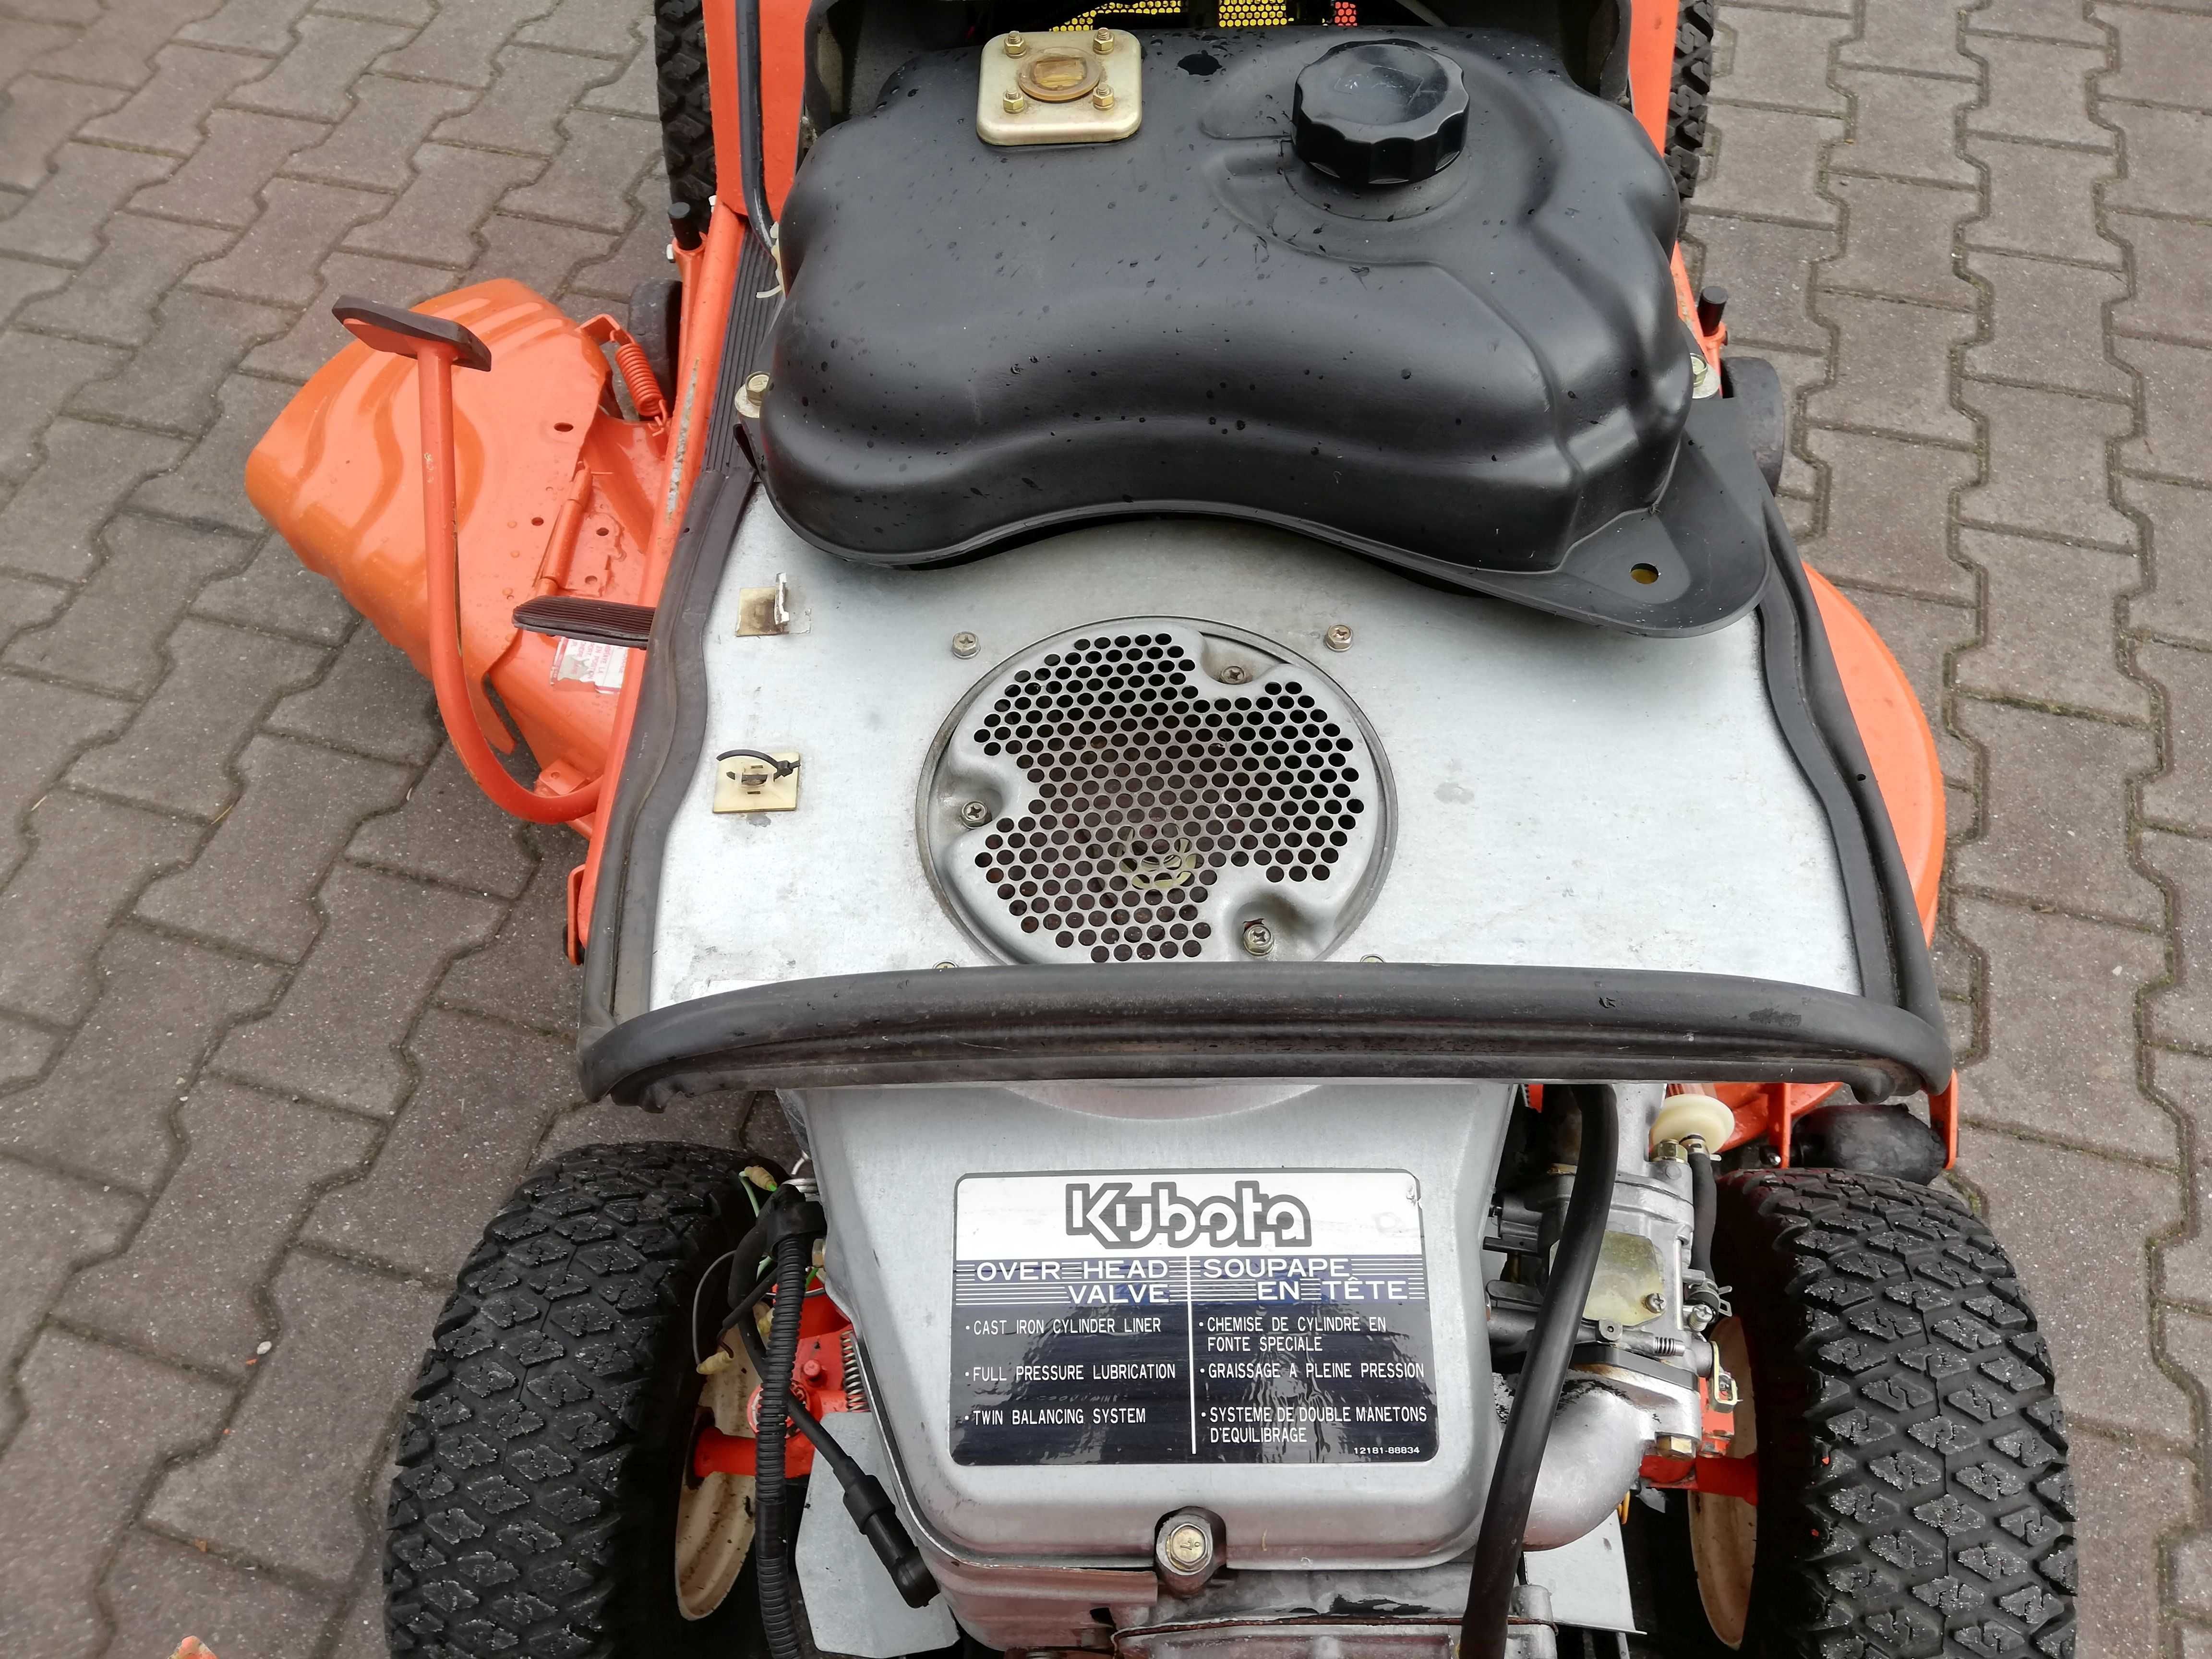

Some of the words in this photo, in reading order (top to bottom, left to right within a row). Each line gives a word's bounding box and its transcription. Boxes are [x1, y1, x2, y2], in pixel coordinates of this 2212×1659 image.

[1066, 1180, 1312, 1249] Kubota
[977, 1261, 1060, 1281] OVER
[1084, 1260, 1168, 1279] HEAD
[1203, 1258, 1350, 1278] SOUPAPE
[1068, 1284, 1169, 1304] VALVE
[1257, 1281, 1300, 1300] EN
[1322, 1276, 1407, 1300] TÊTE
[974, 1320, 1007, 1335] CAST
[1016, 1319, 1044, 1334] IRON
[1053, 1318, 1115, 1333] CYLINDER
[1124, 1317, 1161, 1333] LINER
[1207, 1317, 1263, 1332] CHEMISE
[1272, 1317, 1288, 1332] DE
[1298, 1316, 1360, 1332] CYLINDRE
[1370, 1316, 1386, 1331] EN
[1208, 1336, 1250, 1352] FONTE
[1259, 1336, 1322, 1351] SPECIALE
[973, 1367, 1007, 1382] FULL
[1016, 1365, 1084, 1381] PRESSURE
[1093, 1364, 1176, 1380] LUBRICATION
[1208, 1363, 1281, 1379] GRAISSAGE
[1289, 1363, 1297, 1378] A
[1306, 1363, 1352, 1378] PLEINE
[1361, 1363, 1424, 1378] PRESSION
[973, 1410, 1003, 1425] TWIN
[1012, 1409, 1084, 1425] BALANCING
[1093, 1408, 1146, 1424] SYSTEM
[1210, 1407, 1272, 1422] SYSTEME
[1277, 1407, 1295, 1422] DE
[1299, 1407, 1351, 1422] DOUBLE
[1356, 1407, 1427, 1421] MANETONS
[1210, 1427, 1307, 1443] D'EQUILIBRAGE
